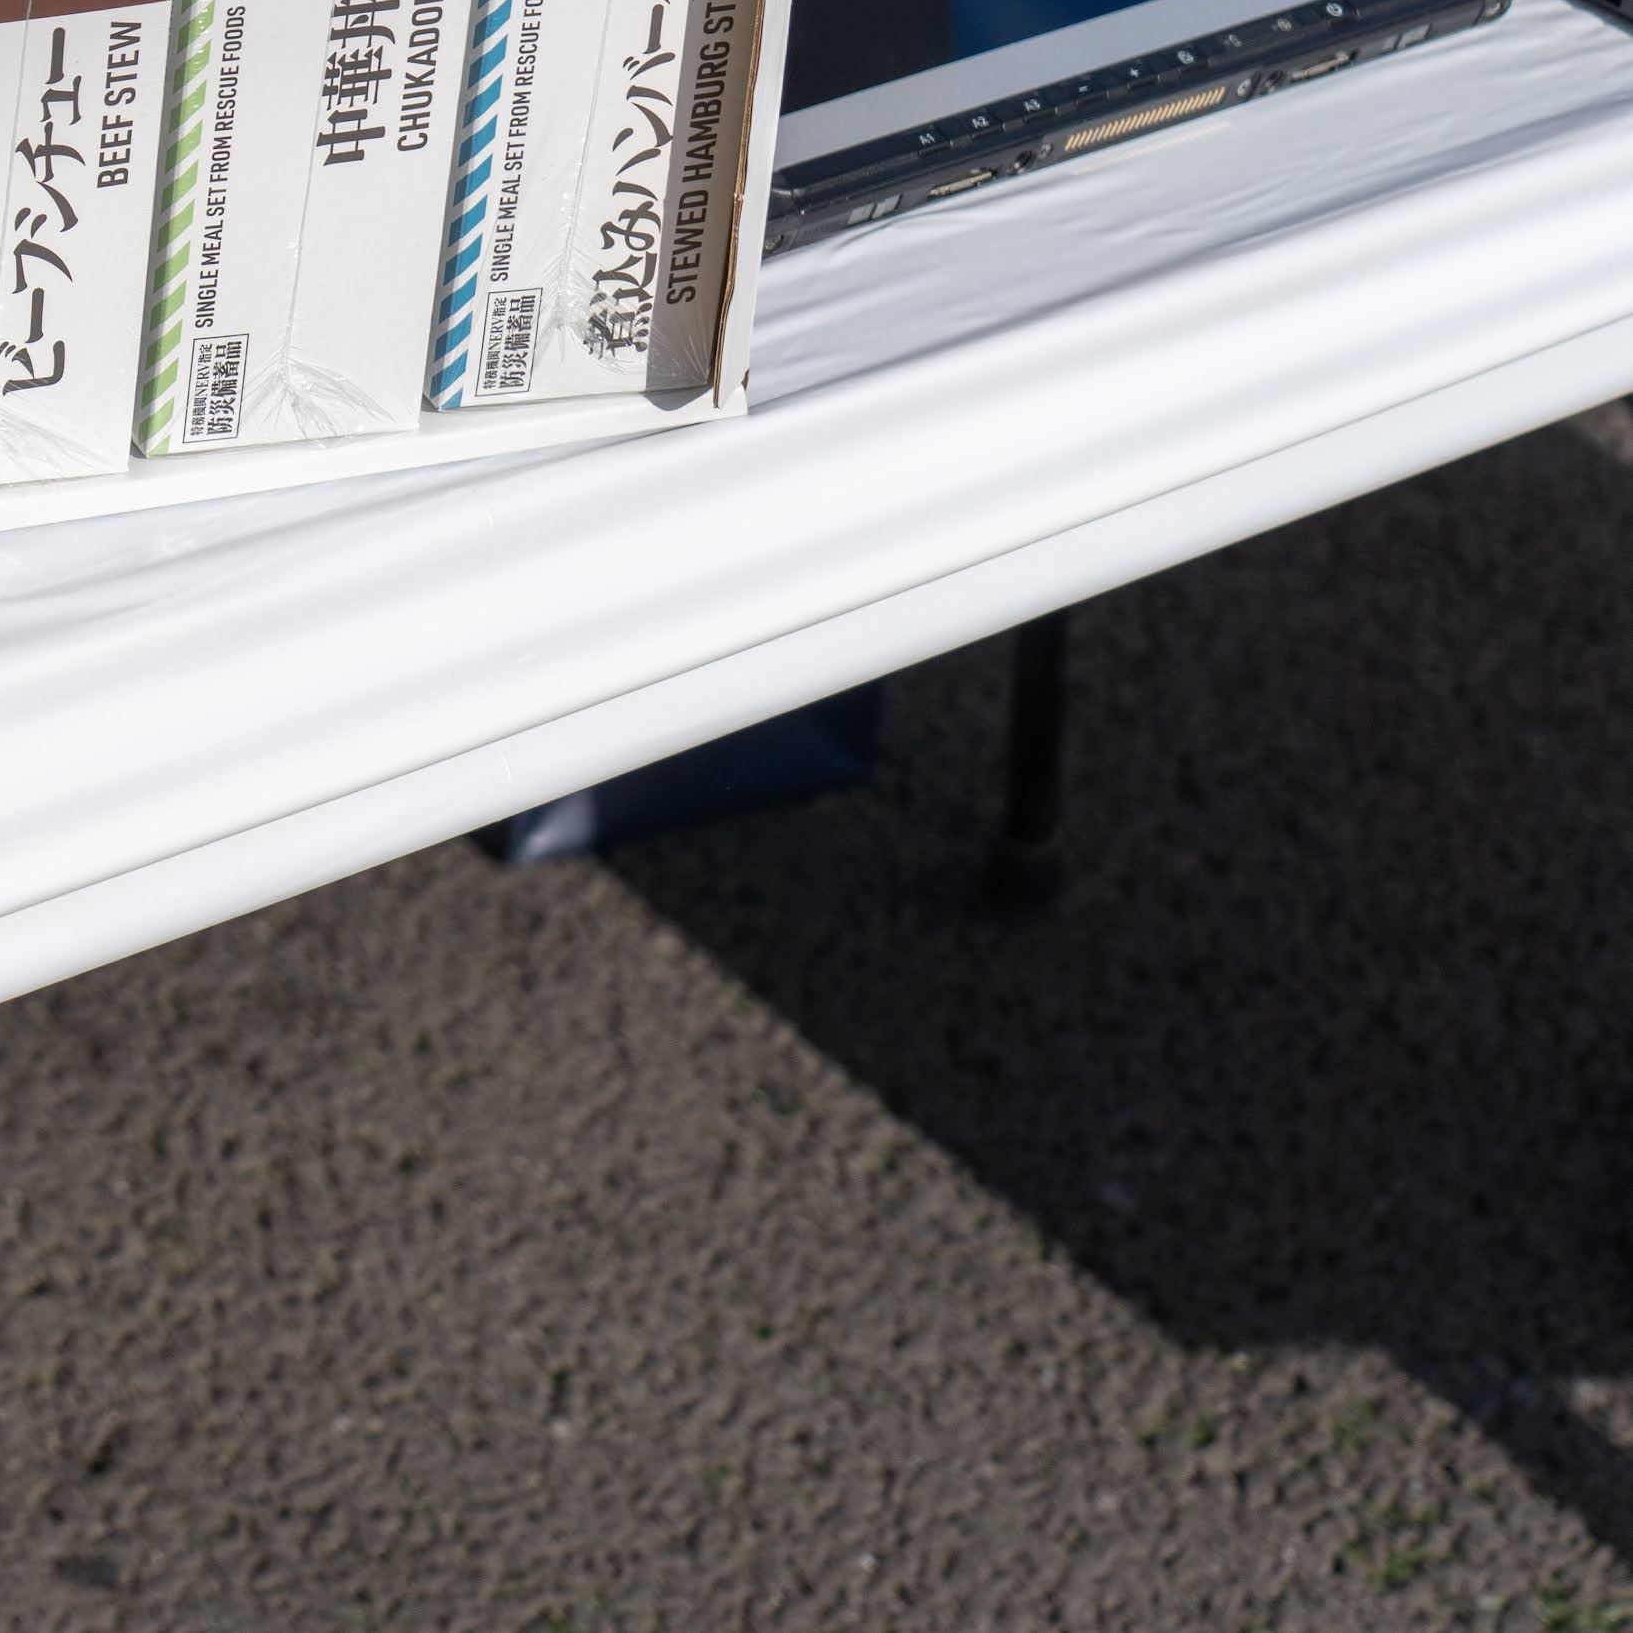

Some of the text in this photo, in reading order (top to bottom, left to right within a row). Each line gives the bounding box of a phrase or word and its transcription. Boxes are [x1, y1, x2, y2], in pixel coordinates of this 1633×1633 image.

[514, 22, 540, 87] RESCUE
[97, 21, 141, 189] BEEF STEW
[508, 91, 531, 137] FROM
[682, 25, 730, 188] HAMBURG
[195, 5, 246, 328] SINGLE MEAL SET FROM RESCUE FOODS
[498, 174, 520, 220] MEAL
[504, 140, 525, 171] SET
[1, 27, 85, 396] ビーフシチュー
[490, 224, 514, 282] SINGLE
[667, 195, 711, 303] STEWED
[207, 340, 242, 437] 防災備蓄品
[483, 296, 507, 390] 特務機関NERV指定
[500, 294, 536, 389] 防災備蓄品
[190, 343, 213, 438] 特務機関NERV指定
